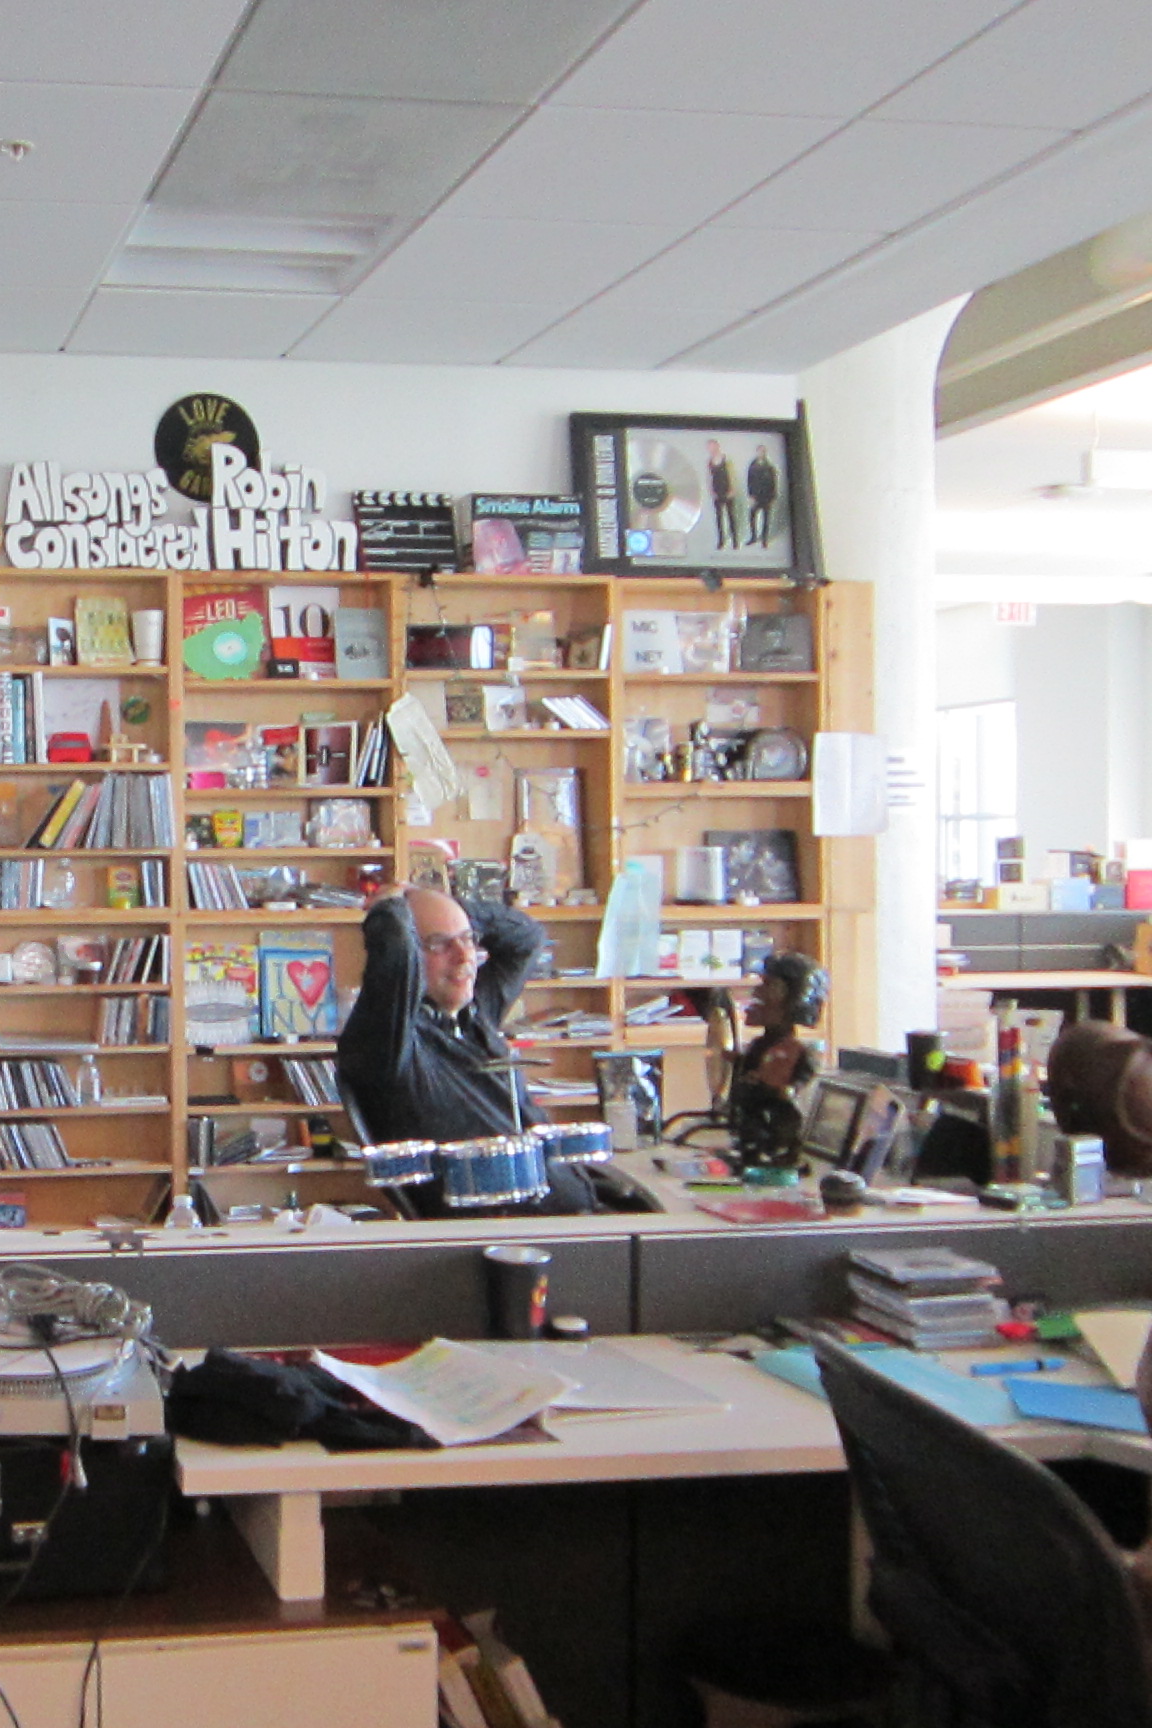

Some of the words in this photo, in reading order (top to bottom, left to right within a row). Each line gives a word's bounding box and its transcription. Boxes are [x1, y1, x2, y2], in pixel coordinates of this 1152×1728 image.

[178, 399, 232, 426] LOVE
[211, 443, 326, 513] Robin
[475, 497, 530, 514] Smoke
[533, 498, 581, 515] Alarm
[211, 507, 357, 570] Hilton
[273, 603, 329, 638] 10
[997, 602, 1030, 622] EXIT
[273, 962, 287, 1000] I
